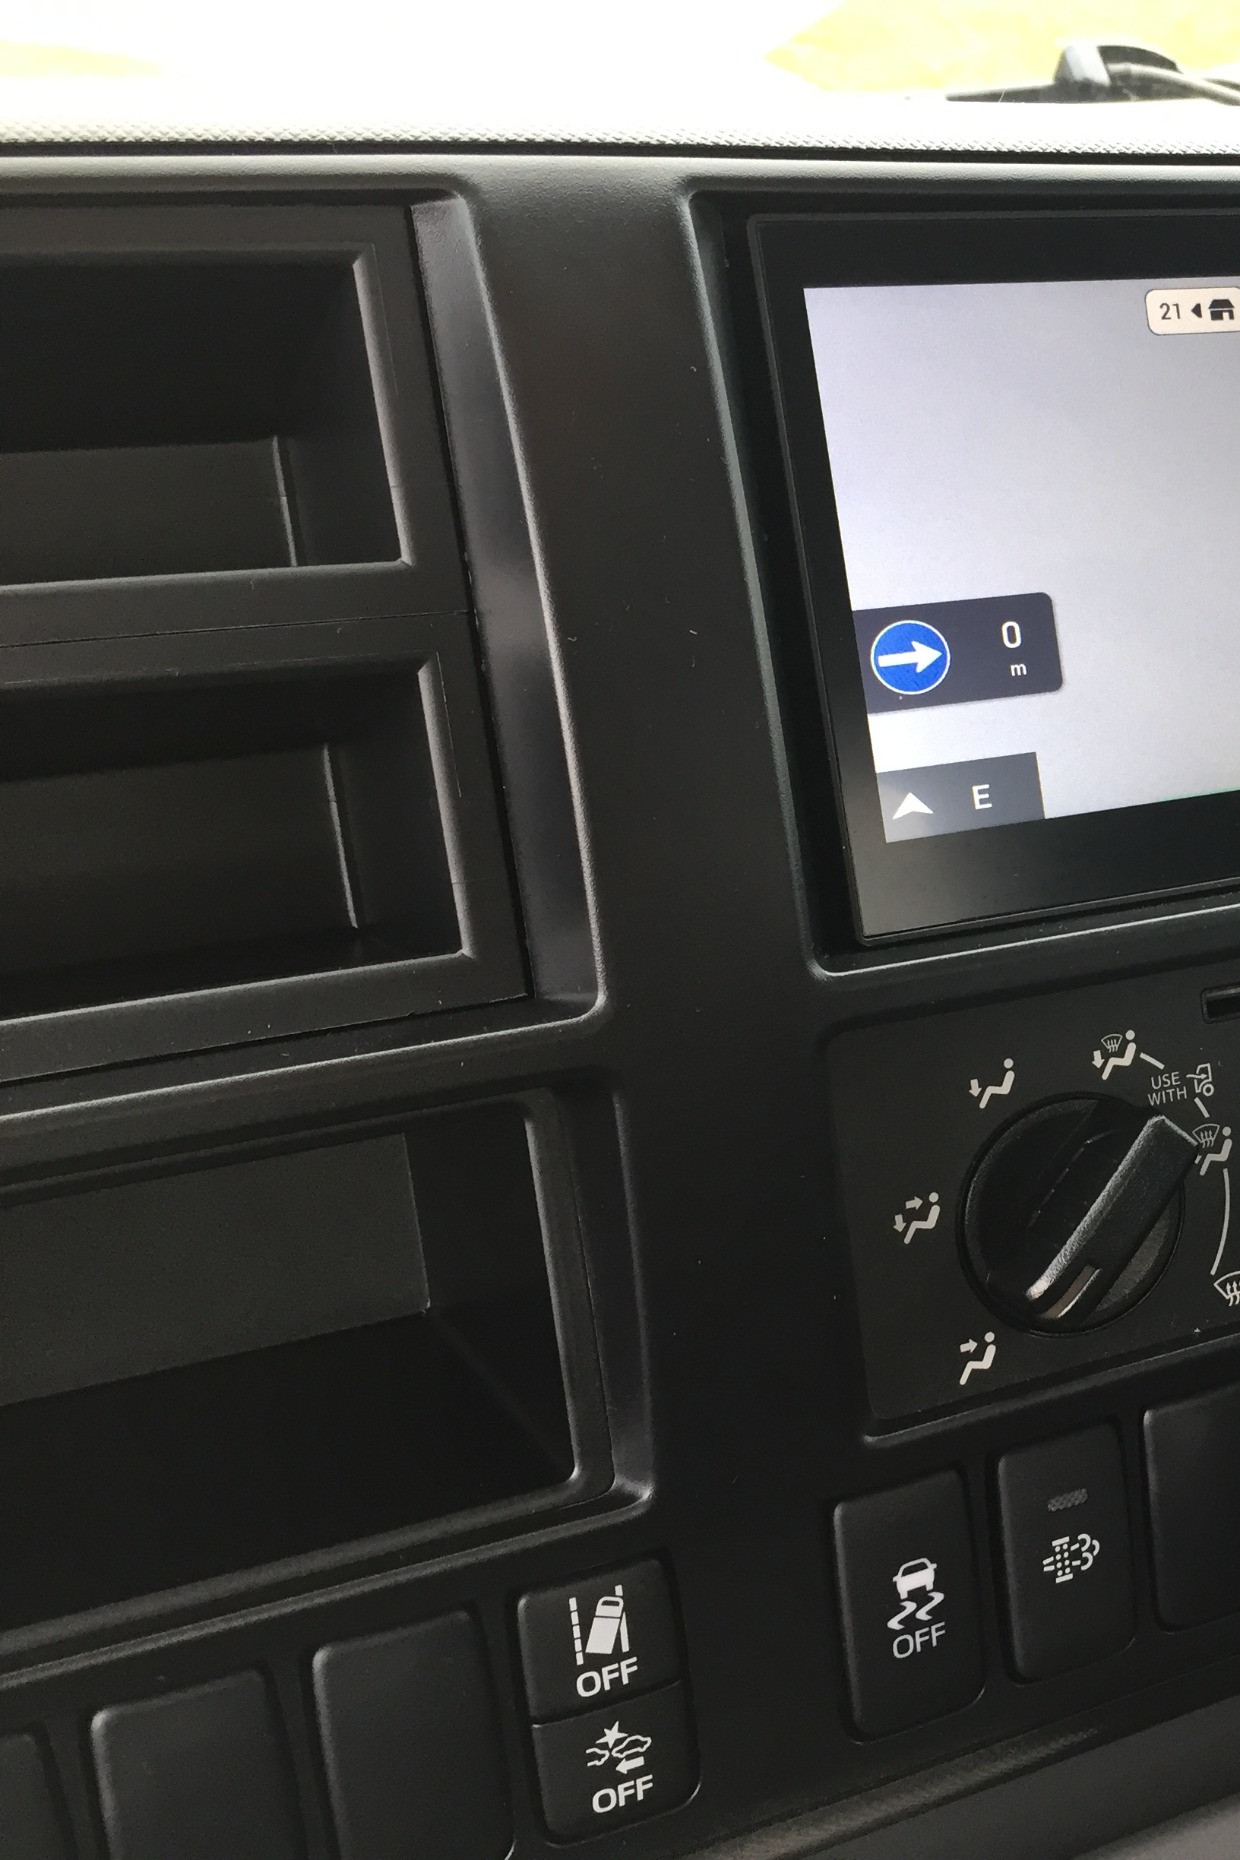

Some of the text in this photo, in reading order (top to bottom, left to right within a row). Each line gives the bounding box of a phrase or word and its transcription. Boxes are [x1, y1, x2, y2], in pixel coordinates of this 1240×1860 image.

[1159, 302, 1181, 321] 21
[1001, 620, 1022, 649] 0
[1010, 663, 1027, 677] m
[971, 783, 993, 810] E
[1151, 1072, 1181, 1089] USE
[1147, 1086, 1187, 1106] WITH
[892, 1622, 946, 1658] OFF
[576, 1657, 638, 1697] OFF
[592, 1775, 653, 1813] OFF
